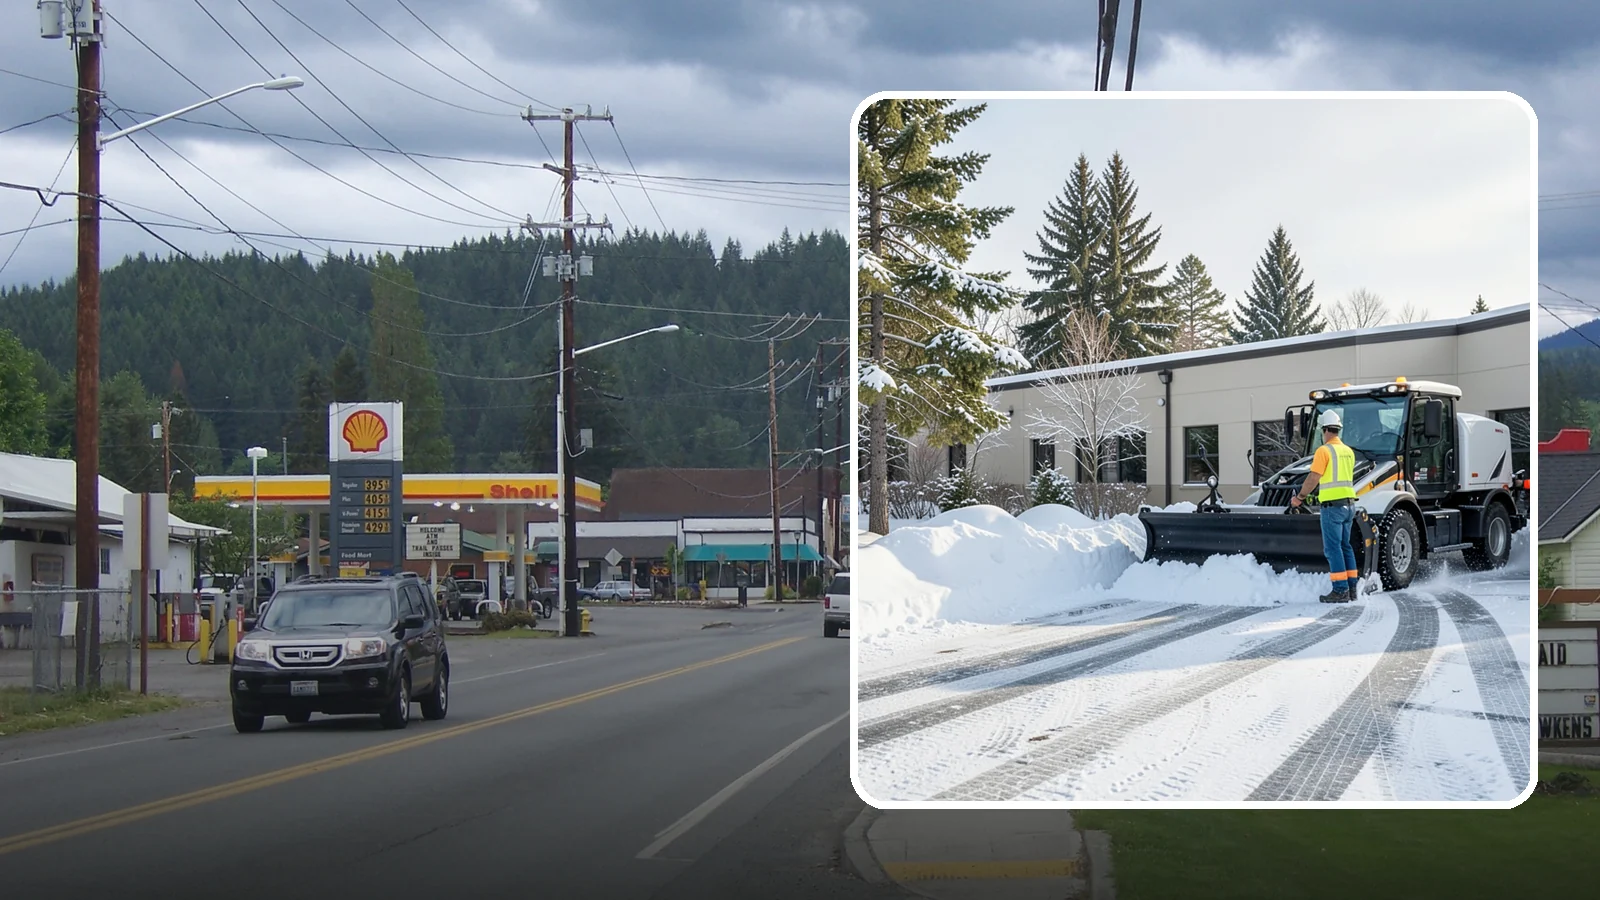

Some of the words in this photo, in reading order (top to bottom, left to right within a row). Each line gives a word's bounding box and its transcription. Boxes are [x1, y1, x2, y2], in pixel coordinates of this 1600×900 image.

[366, 480, 383, 490] 395
[490, 484, 547, 499] Shell
[366, 494, 383, 504] 405
[366, 508, 383, 518] 415
[366, 522, 383, 532] 429
